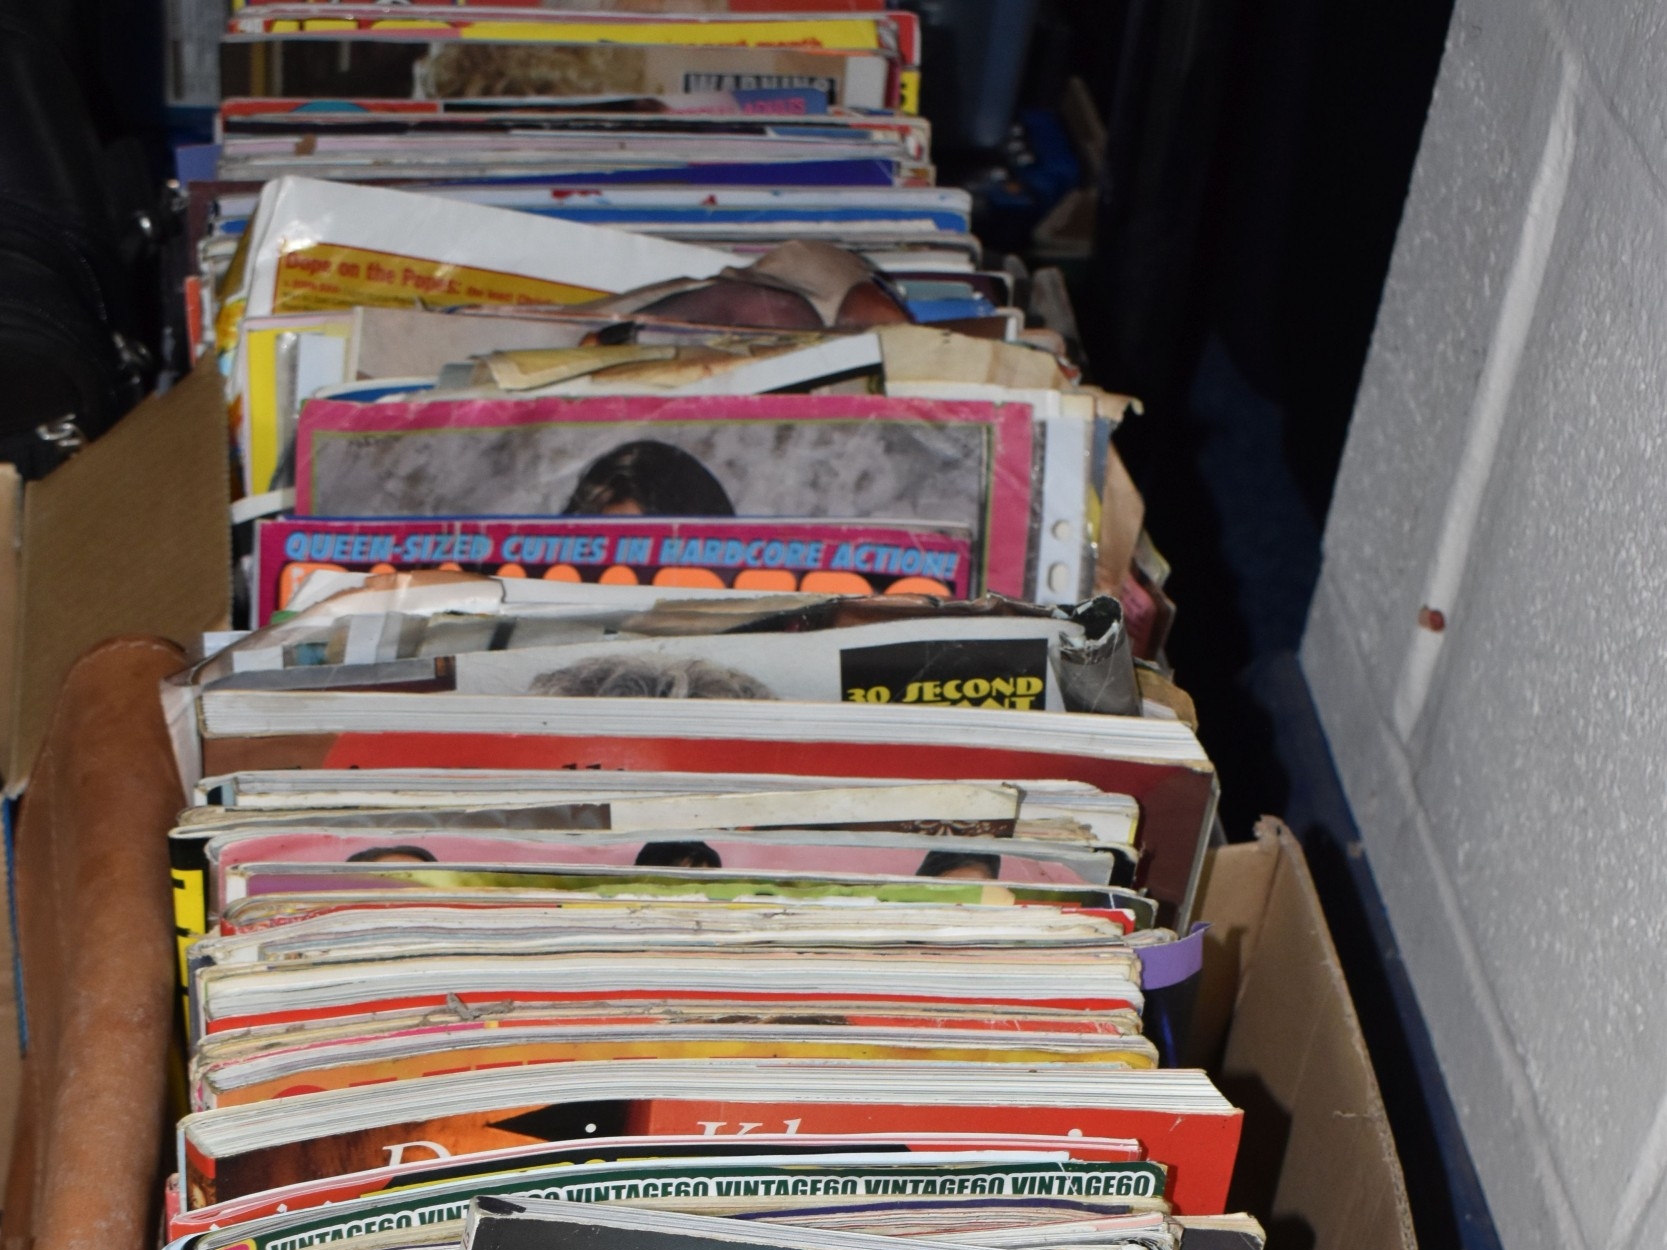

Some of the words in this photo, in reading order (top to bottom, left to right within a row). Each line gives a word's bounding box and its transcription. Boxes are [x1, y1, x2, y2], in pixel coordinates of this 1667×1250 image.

[338, 262, 361, 278] on
[366, 262, 395, 284] the
[285, 531, 493, 563] QUEEN-SIZED
[502, 534, 608, 563] CUTIES
[613, 536, 653, 565] IN
[658, 536, 825, 568] HARDCORE
[830, 542, 961, 580] ACTION!
[902, 676, 1044, 702] SECOND
[566, 1180, 709, 1200] VINTAGE60
[715, 1175, 858, 1198] VINTAGE60
[864, 1176, 1005, 1195] VINTAGE60
[1011, 1174, 1151, 1197] VINTAGE60
